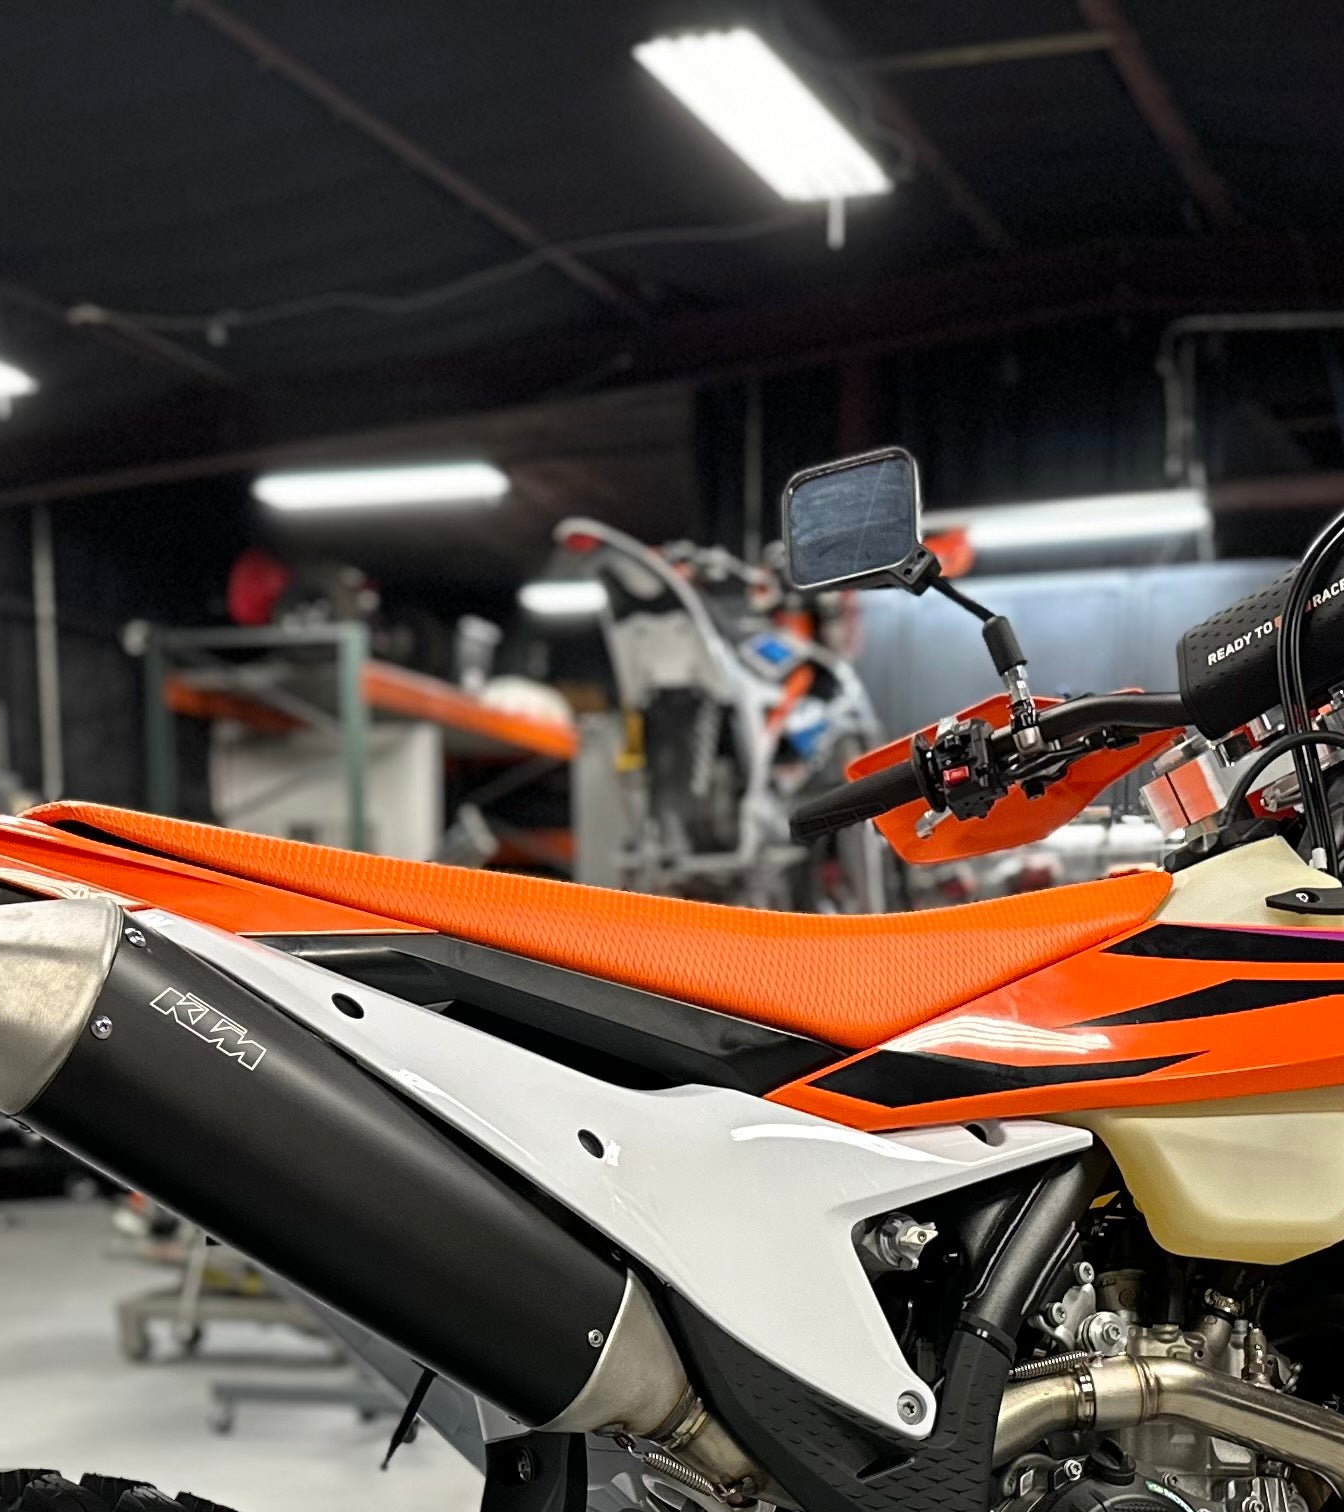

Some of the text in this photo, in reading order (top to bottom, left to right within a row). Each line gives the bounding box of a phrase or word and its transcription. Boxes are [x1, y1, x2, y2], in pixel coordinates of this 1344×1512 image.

[1208, 632, 1252, 666] READY
[1255, 621, 1273, 639] TO
[150, 987, 266, 1071] KTM
